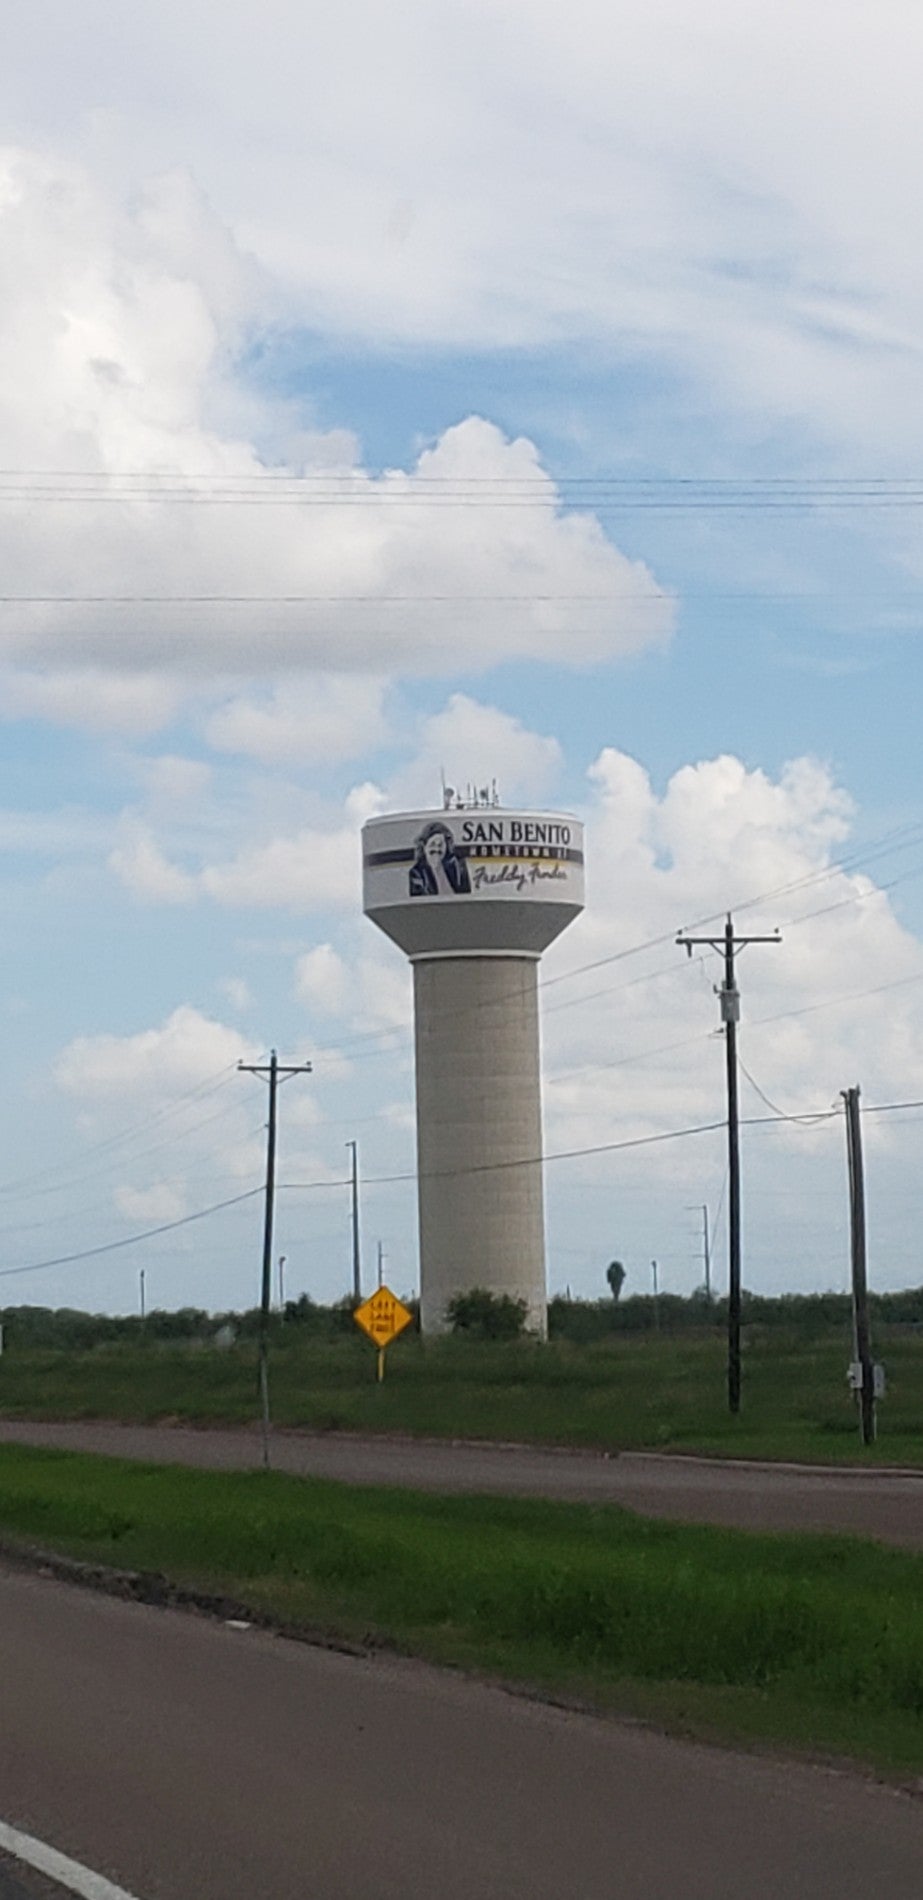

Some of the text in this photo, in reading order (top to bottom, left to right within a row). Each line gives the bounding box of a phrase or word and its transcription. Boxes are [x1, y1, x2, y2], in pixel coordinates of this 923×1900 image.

[462, 821, 571, 845] SAN BENITO
[470, 845, 550, 857] HOMETOWN
[473, 864, 527, 891] Freddy
